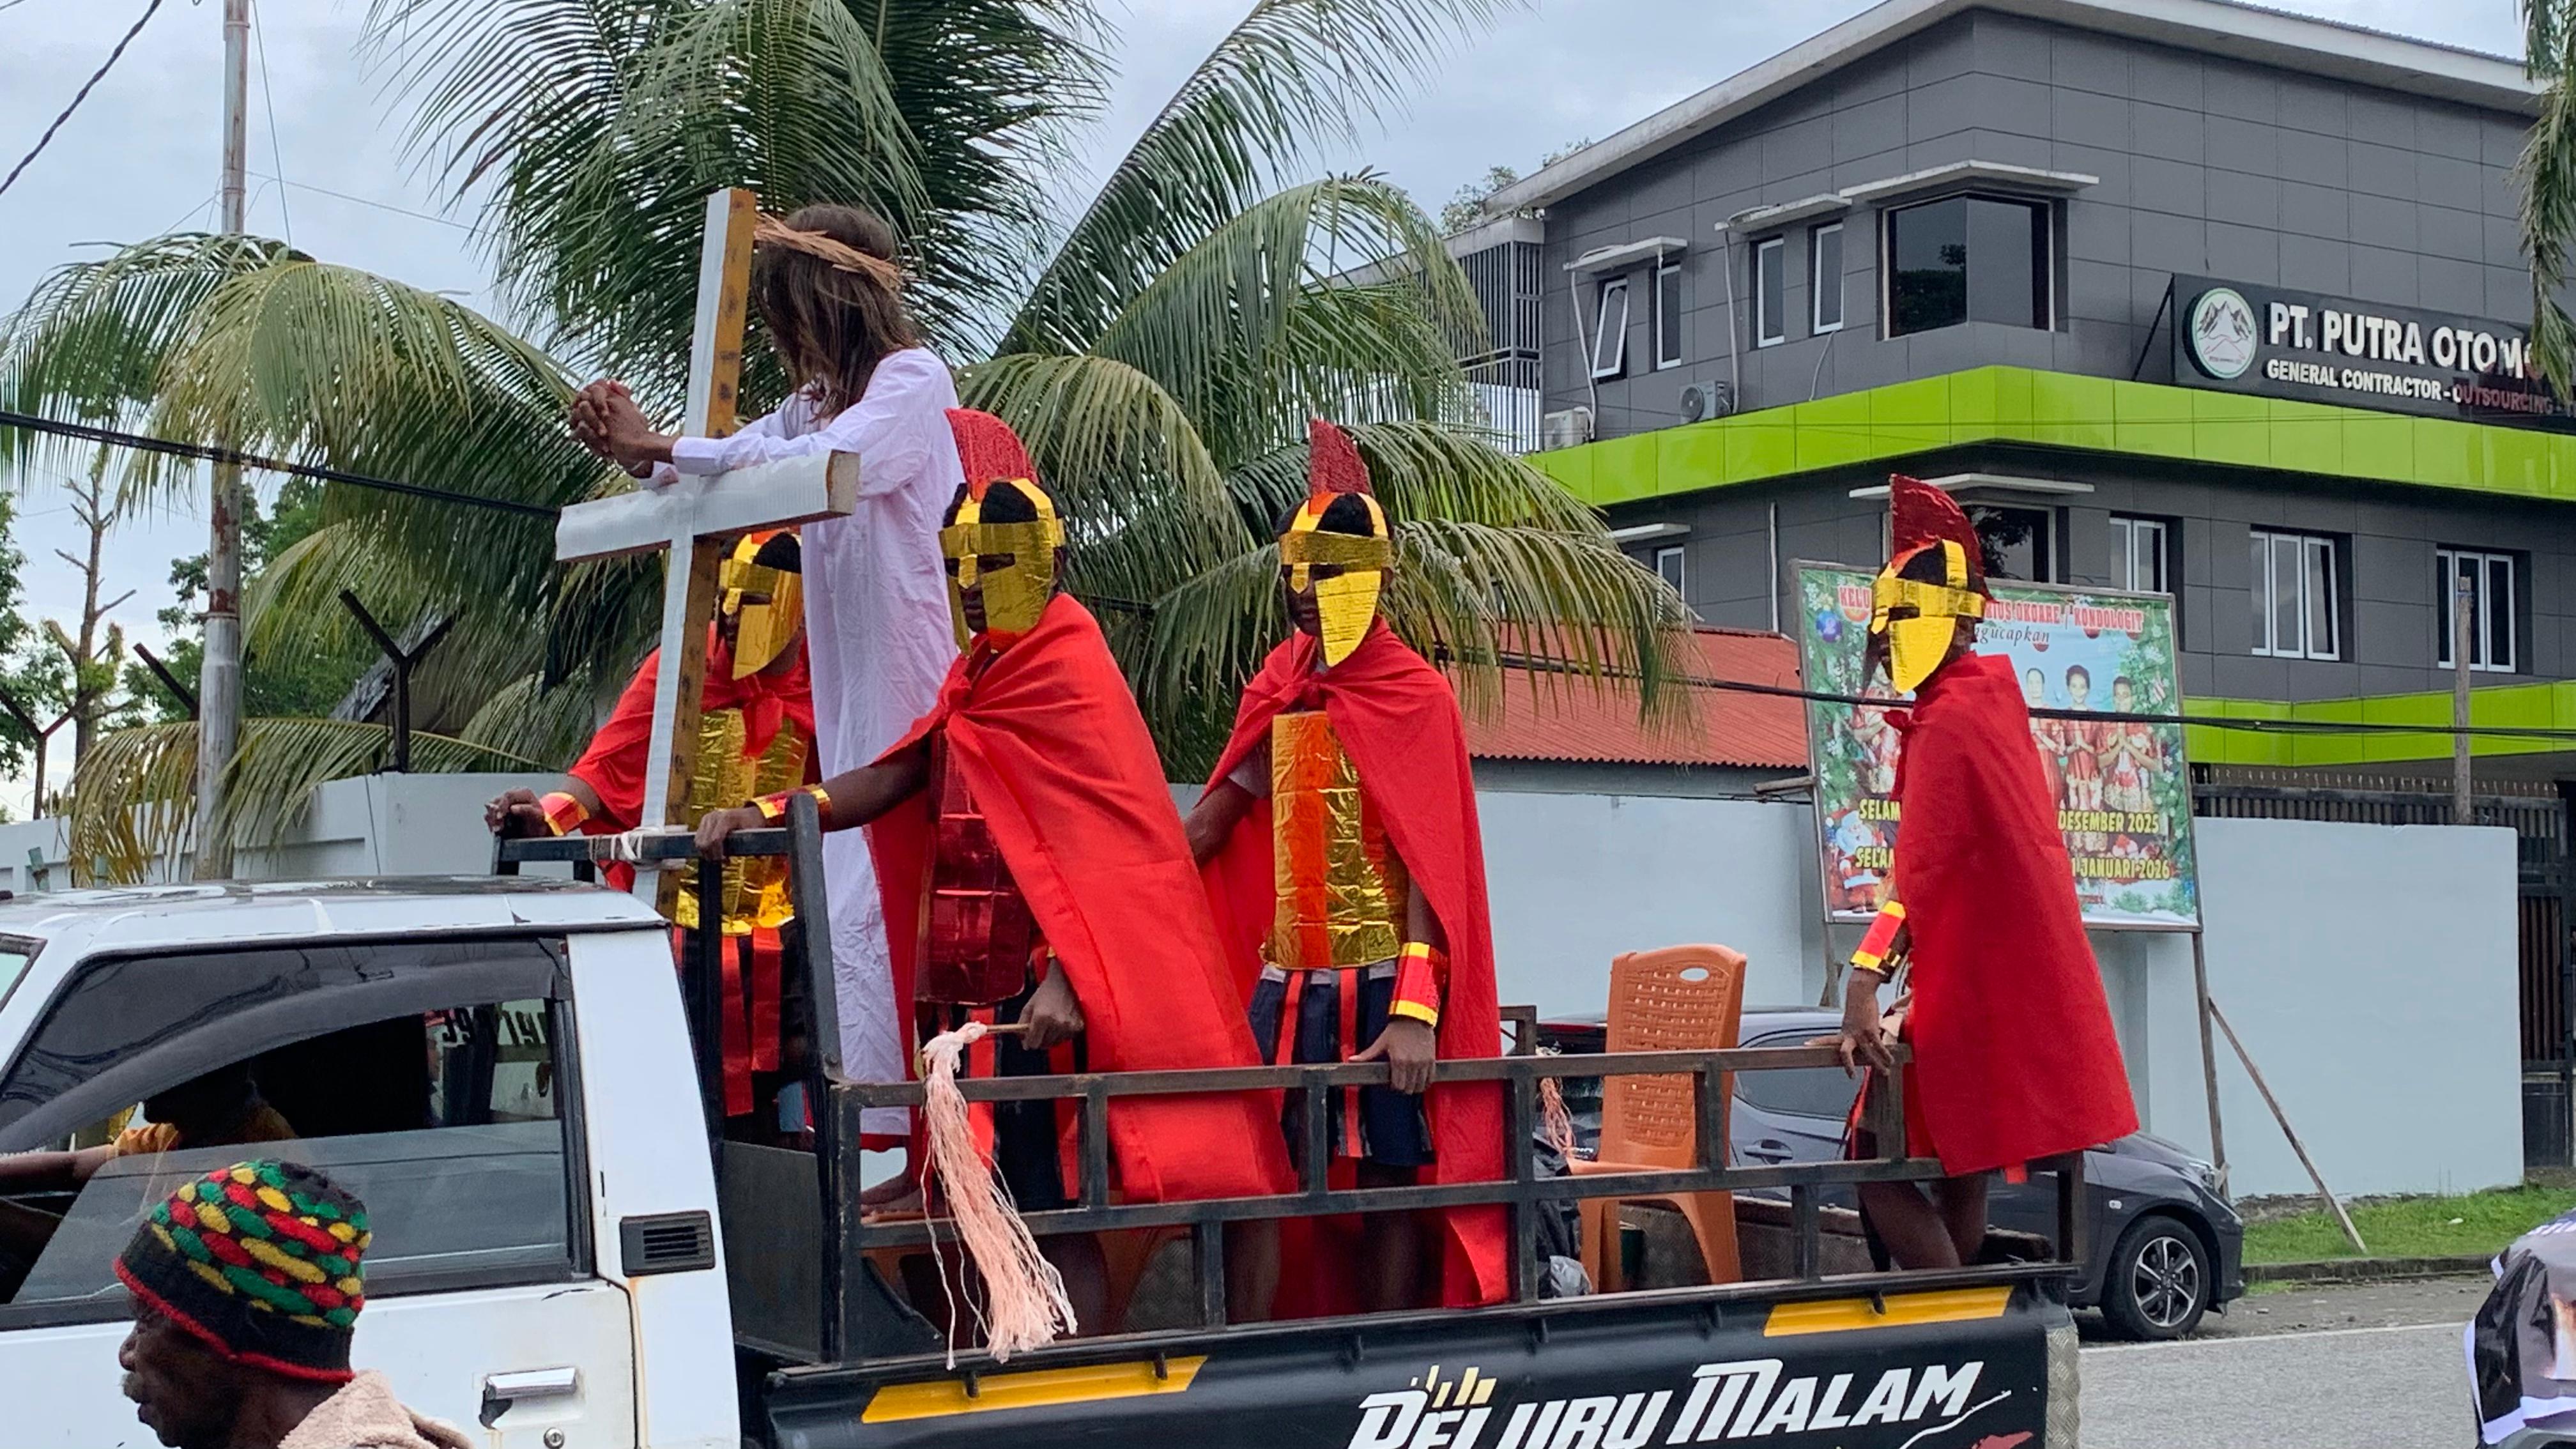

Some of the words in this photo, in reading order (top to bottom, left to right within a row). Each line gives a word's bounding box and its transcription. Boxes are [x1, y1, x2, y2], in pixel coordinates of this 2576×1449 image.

[2270, 302, 2313, 349] PT.
[2324, 310, 2425, 365] PUTRA
[2267, 359, 2338, 387] GENERAL
[2342, 369, 2442, 401] CONTRACTOR
[2453, 384, 2553, 415] OUTSOURCING
[1839, 587, 1872, 609] KELU
[2074, 608, 2143, 631] KONDOLOGIT
[1860, 799, 1901, 821] SELAM
[2058, 811, 2124, 832] DESEMBER
[2128, 814, 2159, 834] 2025
[1855, 847, 1896, 870] SELA
[2080, 857, 2135, 879] JANUARI
[2138, 859, 2170, 880] 2026
[1666, 1358, 1984, 1445] MALAM
